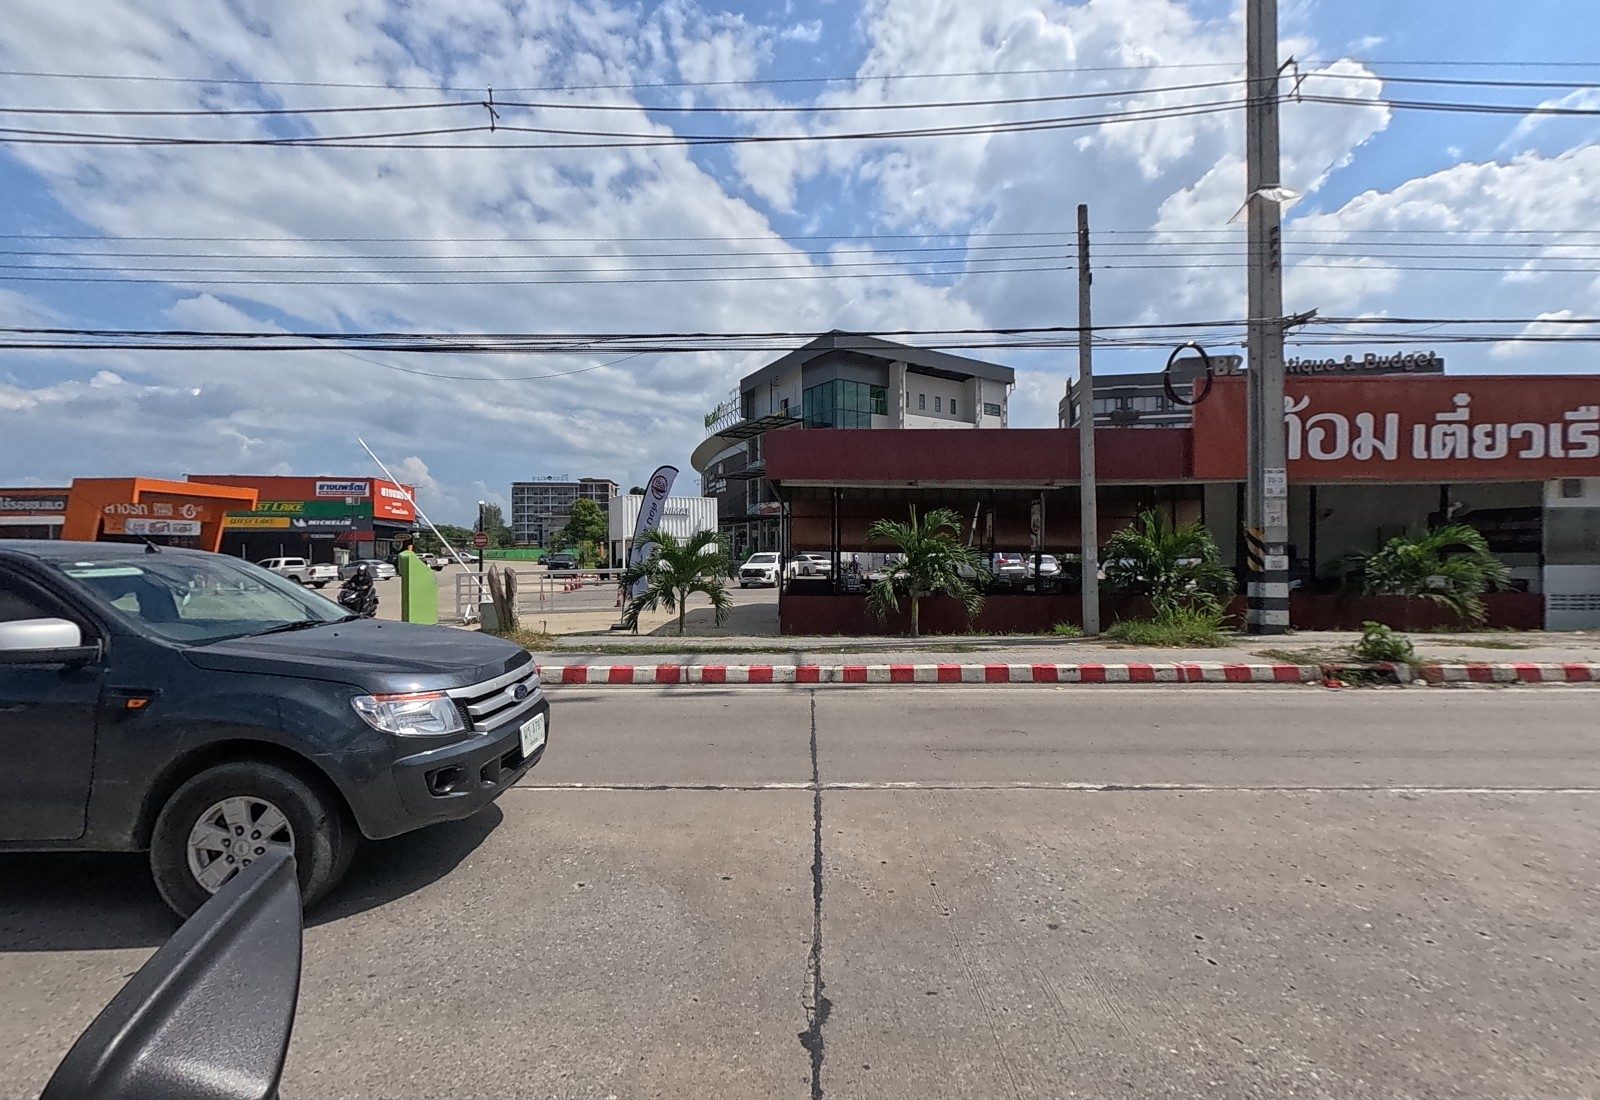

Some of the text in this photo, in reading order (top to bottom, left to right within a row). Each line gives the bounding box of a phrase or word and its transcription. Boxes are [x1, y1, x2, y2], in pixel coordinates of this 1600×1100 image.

[1214, 351, 1437, 376] B2 tique & Budget
[661, 507, 690, 515] NIMAL
